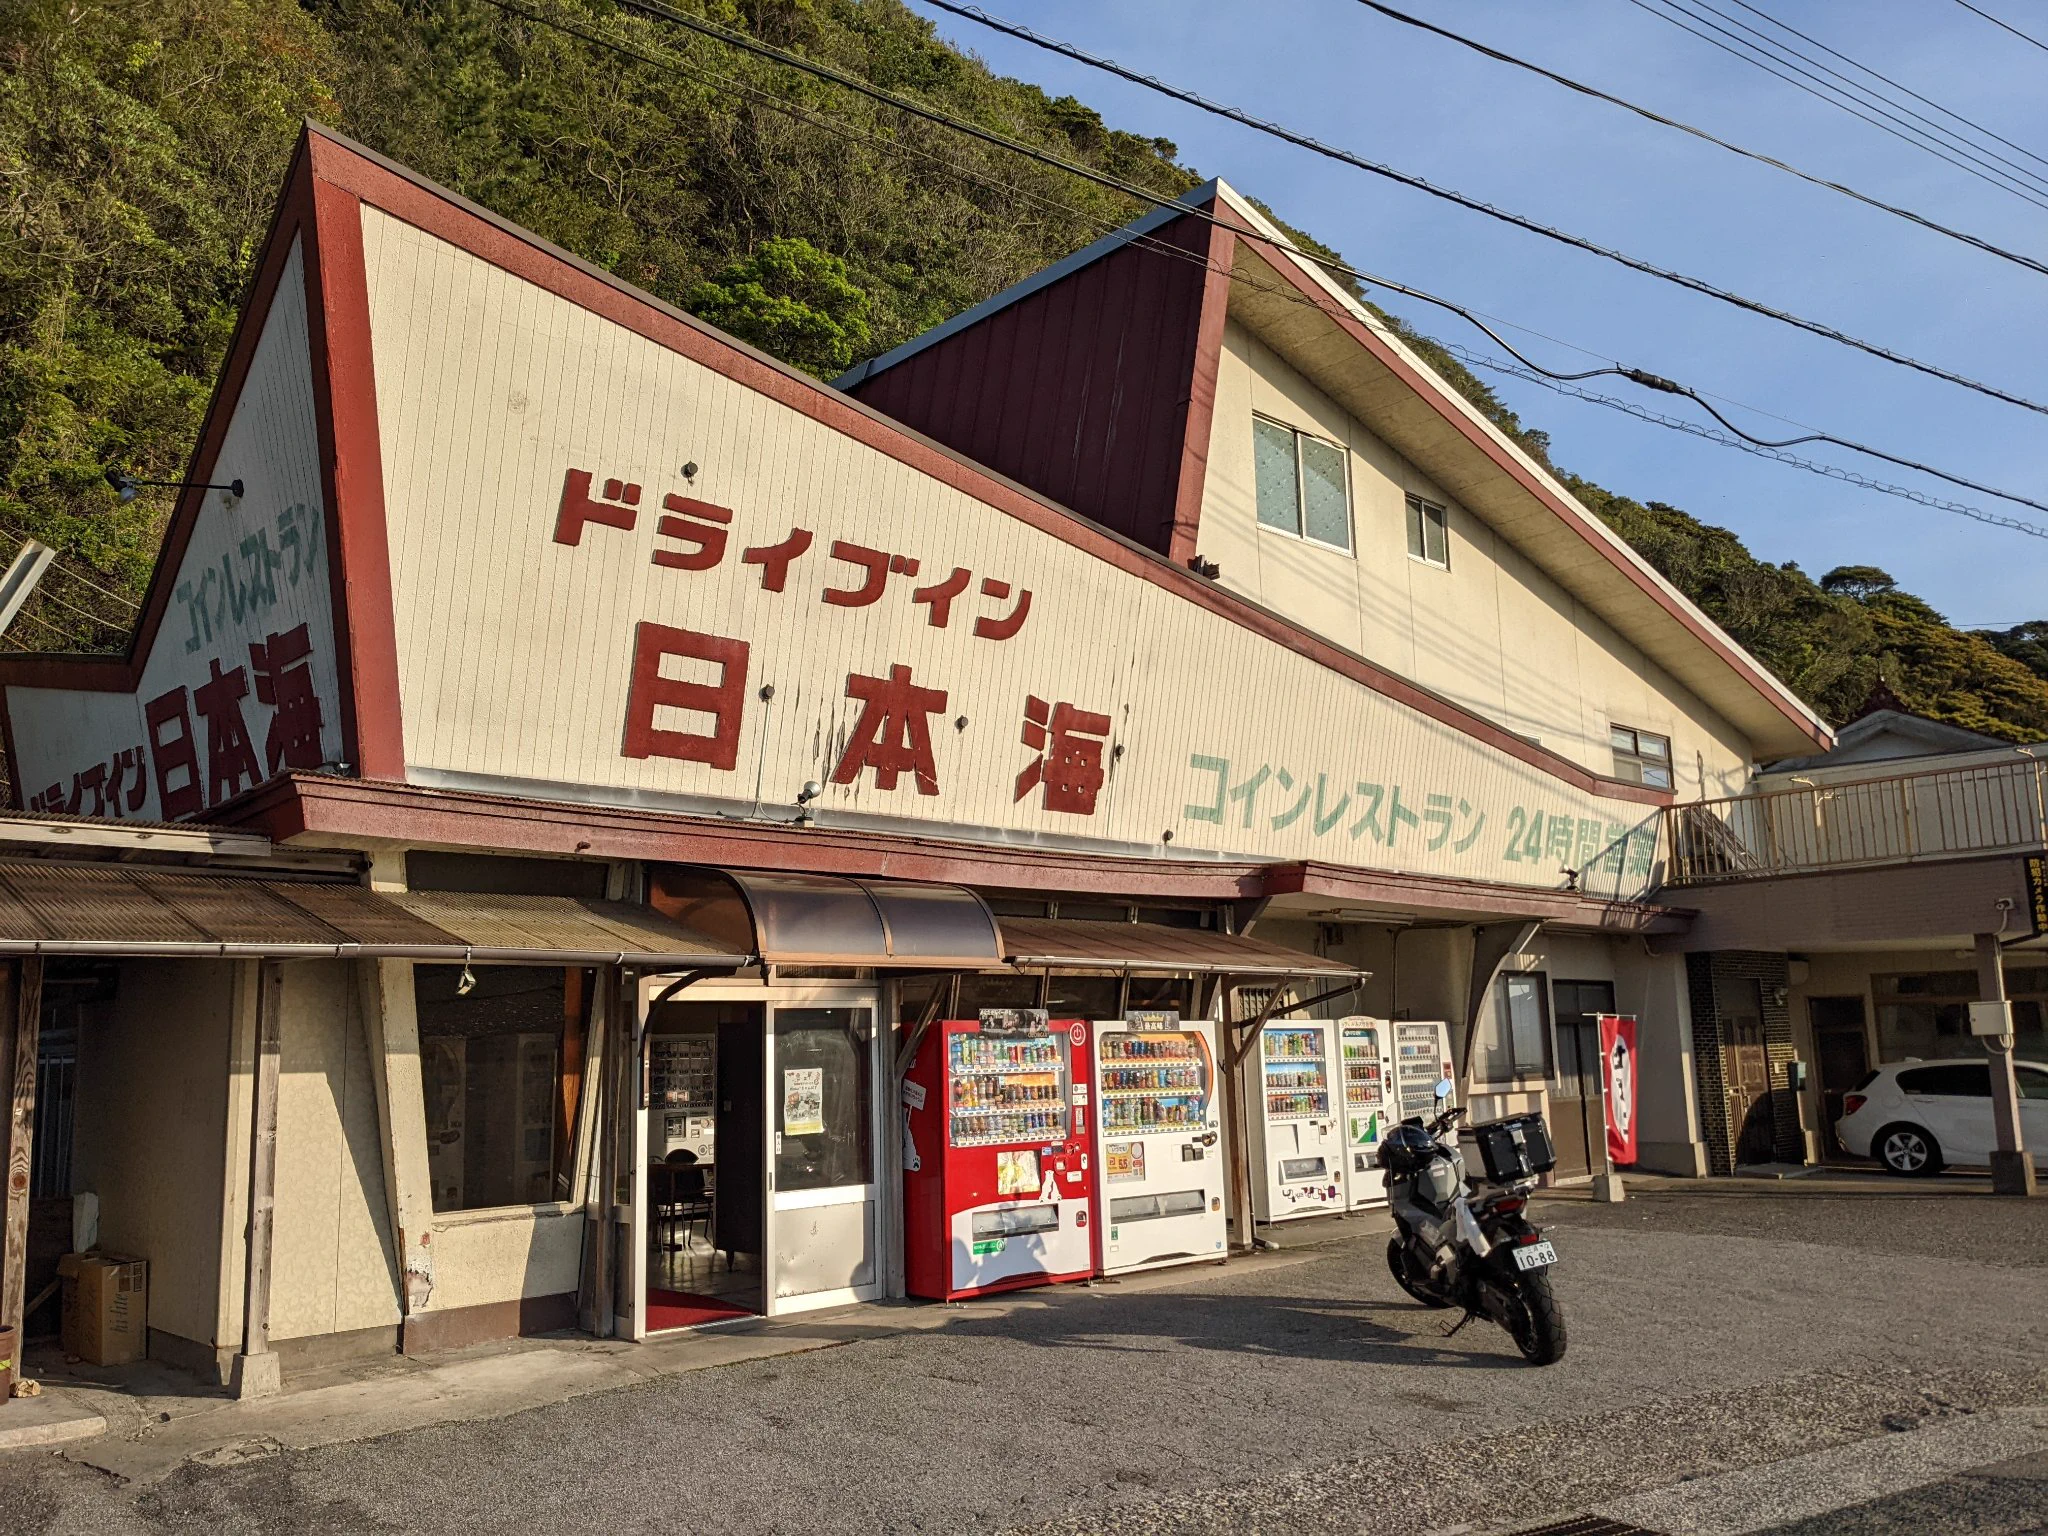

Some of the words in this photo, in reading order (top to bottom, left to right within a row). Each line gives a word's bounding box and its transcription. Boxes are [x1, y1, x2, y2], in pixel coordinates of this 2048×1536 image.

[176, 502, 319, 654] コインレストラン
[553, 468, 1032, 640] ドライブイン
[145, 622, 324, 822] 日本海
[622, 621, 1112, 814] 日本海
[1184, 753, 1486, 855] コインレストラン
[1503, 805, 1656, 878] 24時間営業
[1520, 1250, 1555, 1269] 10-88
